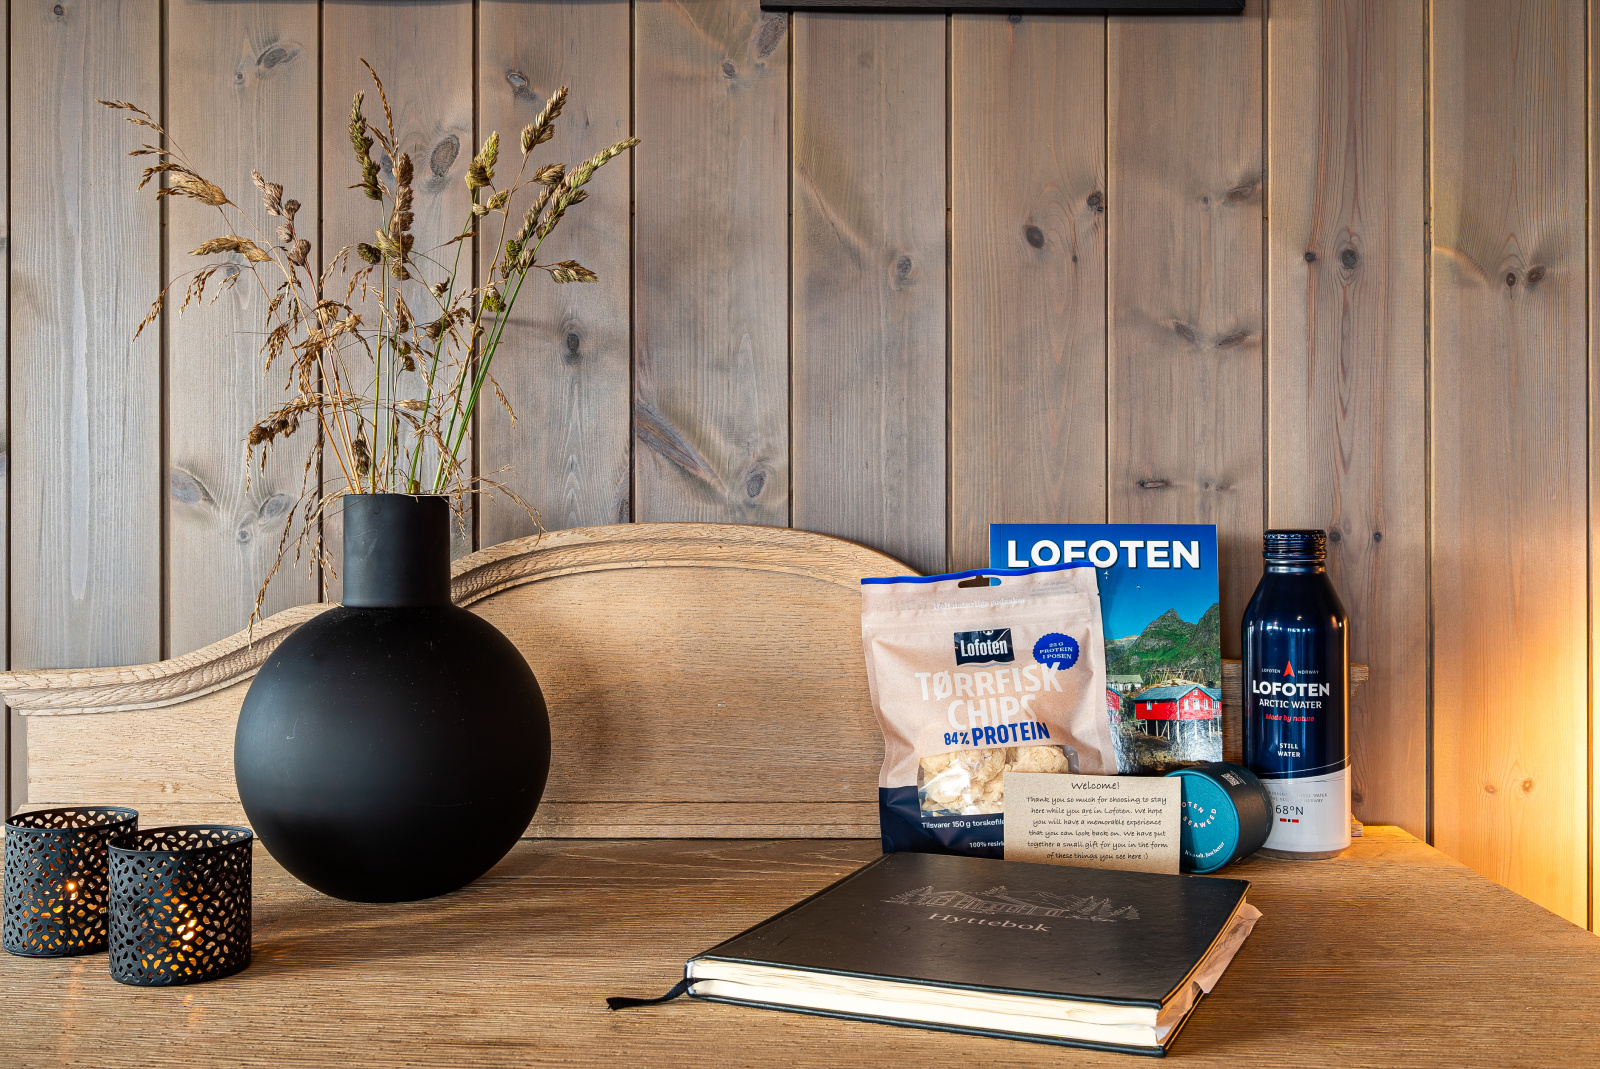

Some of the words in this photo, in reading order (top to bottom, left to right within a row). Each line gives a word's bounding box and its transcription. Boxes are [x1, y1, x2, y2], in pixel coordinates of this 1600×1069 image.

[1007, 539, 1200, 569] LOFOTEN
[960, 639, 1008, 657] Lofoten
[1040, 646, 1073, 654] PROTEIN
[915, 662, 1064, 701] TØRRFISK
[1252, 680, 1330, 696] LOFOTEN
[1259, 698, 1290, 708] ARCTIC
[1291, 700, 1322, 708] WATER
[947, 694, 1038, 731] CHIPS
[1283, 714, 1292, 722] by
[944, 732, 970, 746] 84%
[972, 722, 1051, 746] PROTEIN
[1280, 742, 1298, 750] STILL
[1278, 750, 1300, 758] WATER
[1072, 781, 1120, 790] Welcome!
[1098, 796, 1107, 804] for
[1110, 796, 1140, 804] choosing
[1150, 797, 1166, 805] stay
[1066, 808, 1080, 816] you
[1104, 807, 1132, 816] Lofoten.
[1148, 808, 1162, 816] hope
[1276, 804, 1304, 816] 68°N
[1182, 808, 1217, 828] SEAWEED
[952, 820, 965, 828] 150
[1126, 819, 1162, 828] experience
[1154, 830, 1166, 838] put
[1084, 840, 1098, 849] gift
[1100, 841, 1110, 850] for
[1112, 842, 1126, 850] you
[1150, 841, 1168, 849] form
[1074, 852, 1098, 860] things
[927, 913, 1052, 932] Hyttebok
